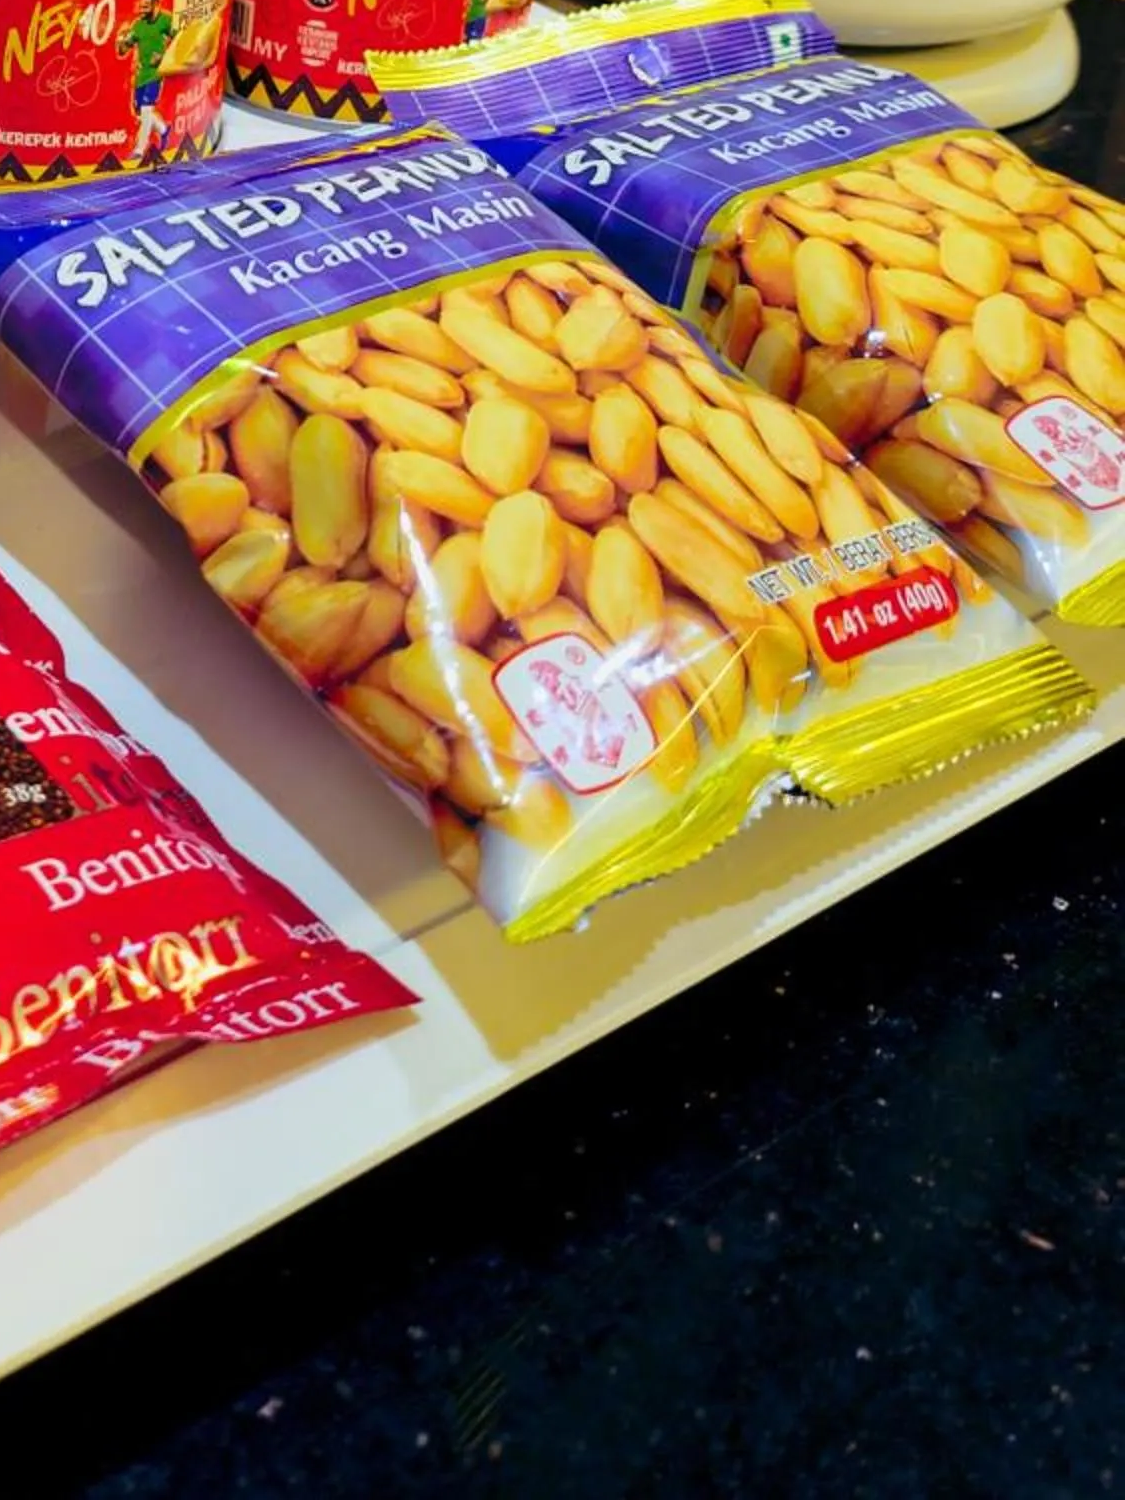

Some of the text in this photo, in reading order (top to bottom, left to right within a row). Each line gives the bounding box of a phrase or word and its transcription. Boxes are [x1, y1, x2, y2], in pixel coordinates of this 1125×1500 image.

[253, 36, 288, 62] MY
[564, 61, 909, 187] SALTED PEANU
[707, 84, 949, 166] Kacang Masin
[55, 189, 300, 307] SALTED
[229, 189, 536, 296] Kacang Masin
[747, 566, 795, 605] NET
[832, 532, 892, 573] BERAT
[823, 575, 951, 646] 1.41 oz (40g)
[1, 781, 48, 808] 38g
